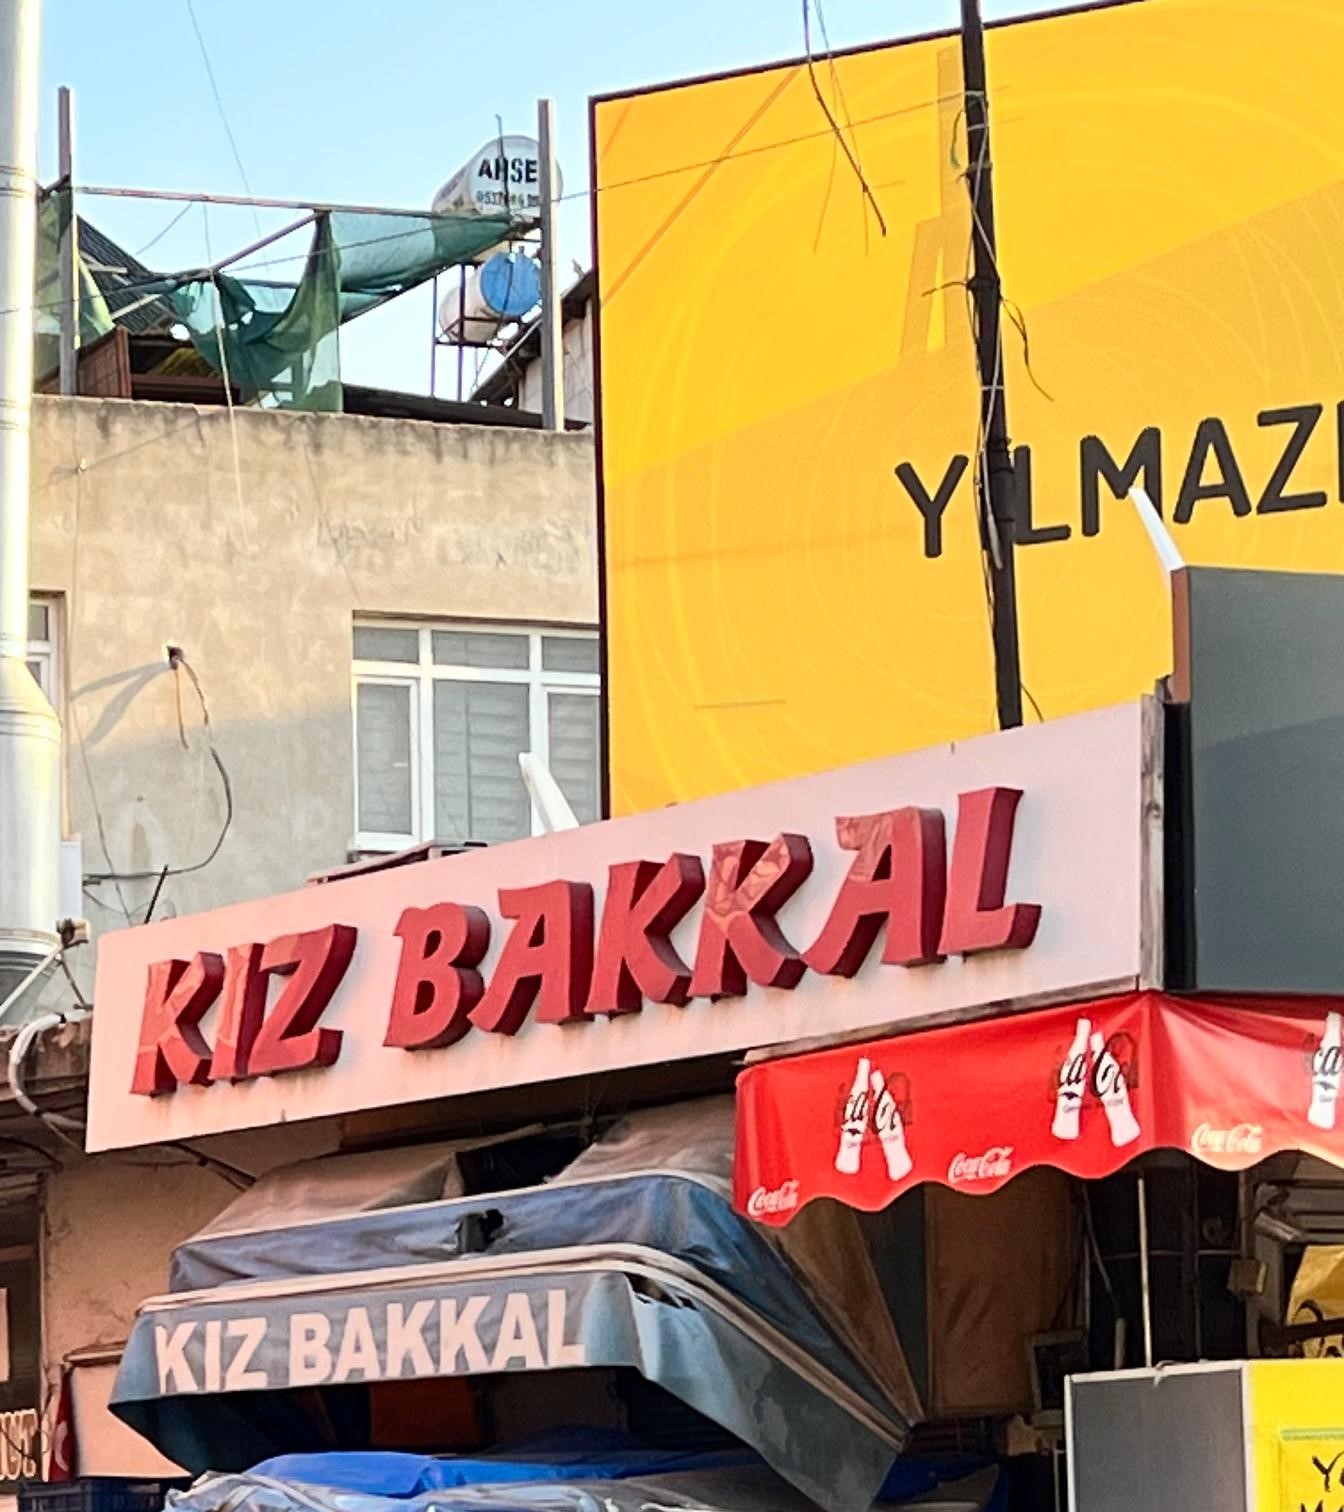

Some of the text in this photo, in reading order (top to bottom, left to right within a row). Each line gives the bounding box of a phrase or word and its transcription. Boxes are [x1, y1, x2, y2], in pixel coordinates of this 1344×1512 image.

[477, 158, 538, 183] ARSE
[894, 400, 1344, 559] YLMAZ
[130, 786, 1043, 1095] KIZ BAKKAL
[947, 1147, 1014, 1183] Coca-Cola
[1190, 1122, 1263, 1152] Coca-Cola
[155, 1289, 587, 1395] KIZ BAKKAL
